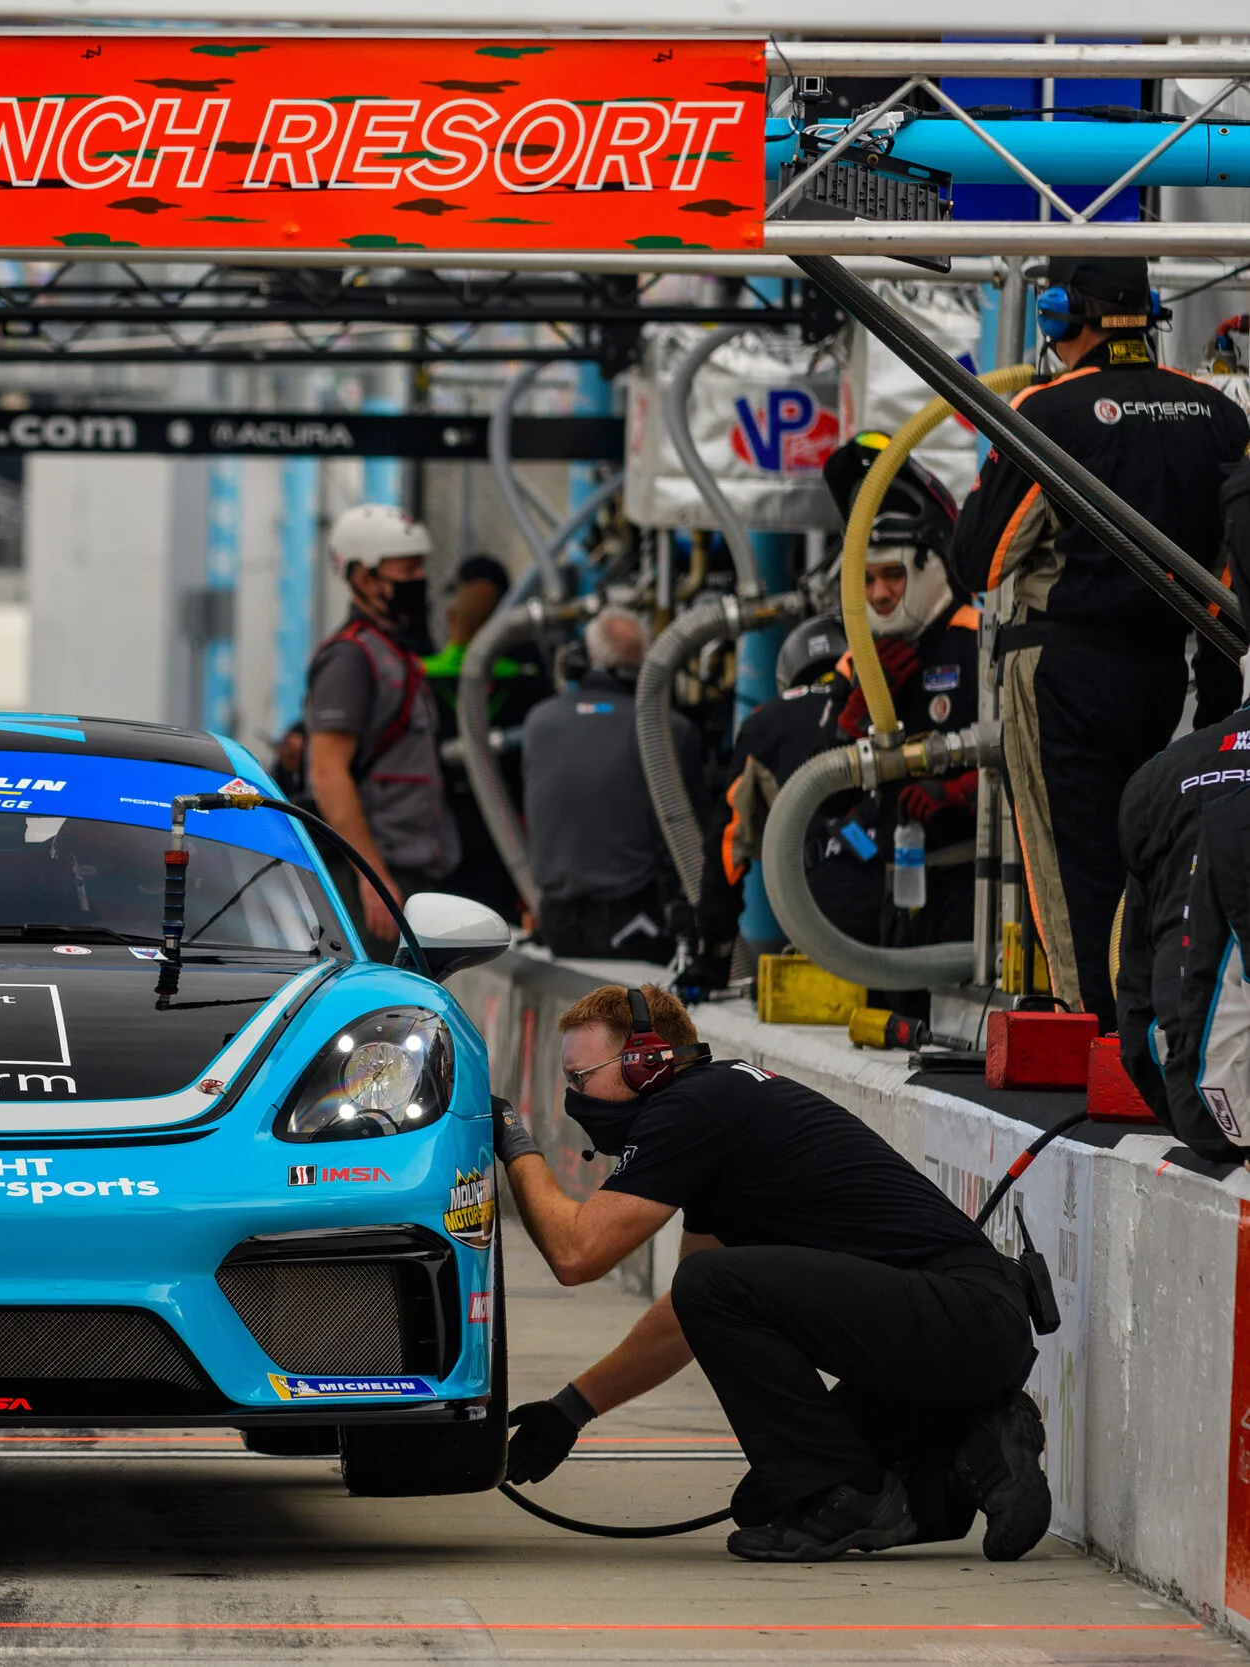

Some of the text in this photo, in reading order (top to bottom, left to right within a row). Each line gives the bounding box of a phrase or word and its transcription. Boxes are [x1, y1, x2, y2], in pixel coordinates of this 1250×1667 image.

[243, 98, 746, 193] RESORT
[735, 389, 813, 471] VP
[1123, 402, 1212, 419] CAMERON
[322, 1167, 392, 1182] IMSA
